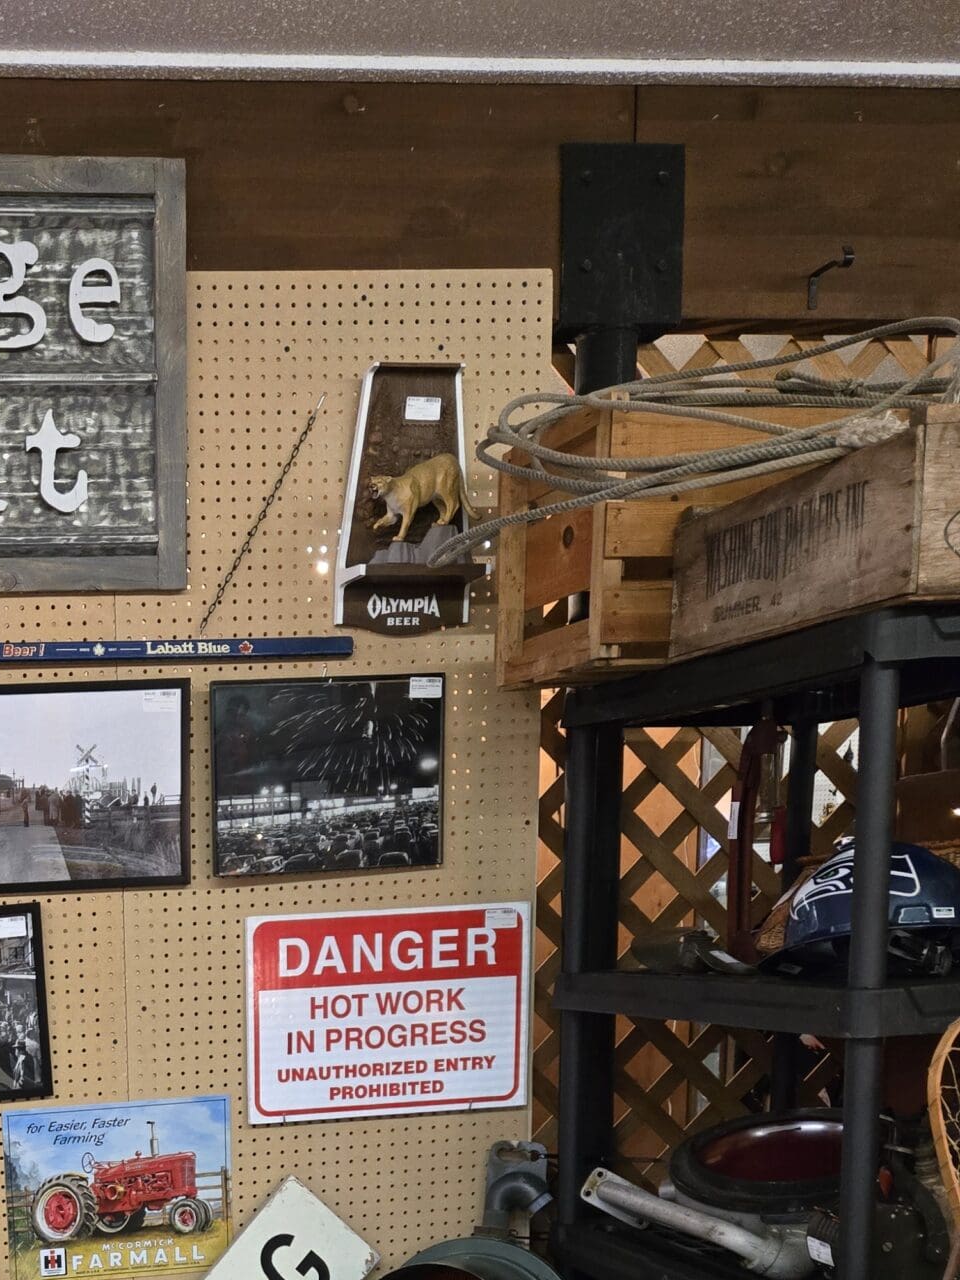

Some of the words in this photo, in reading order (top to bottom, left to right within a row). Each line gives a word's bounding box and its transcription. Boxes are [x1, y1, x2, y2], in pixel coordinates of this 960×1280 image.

[367, 593, 440, 619] OLYMPIA
[386, 616, 420, 627] BEER
[146, 640, 195, 655] Labatt
[197, 640, 231, 654] Blue
[278, 926, 498, 978] DANGER
[309, 993, 369, 1020] HOT
[375, 987, 466, 1015] WORK
[286, 1029, 315, 1055] IN
[325, 1019, 487, 1052] PROGRESS
[277, 1059, 428, 1083] UNAUTHORIZED
[434, 1055, 497, 1073] ENTRY
[329, 1080, 445, 1101] PROHIBITED
[26, 1122, 45, 1136] for
[48, 1119, 89, 1134] Easier,
[91, 1116, 132, 1130] Faster
[52, 1131, 106, 1147] Farming
[71, 1244, 205, 1271] FARMALL
